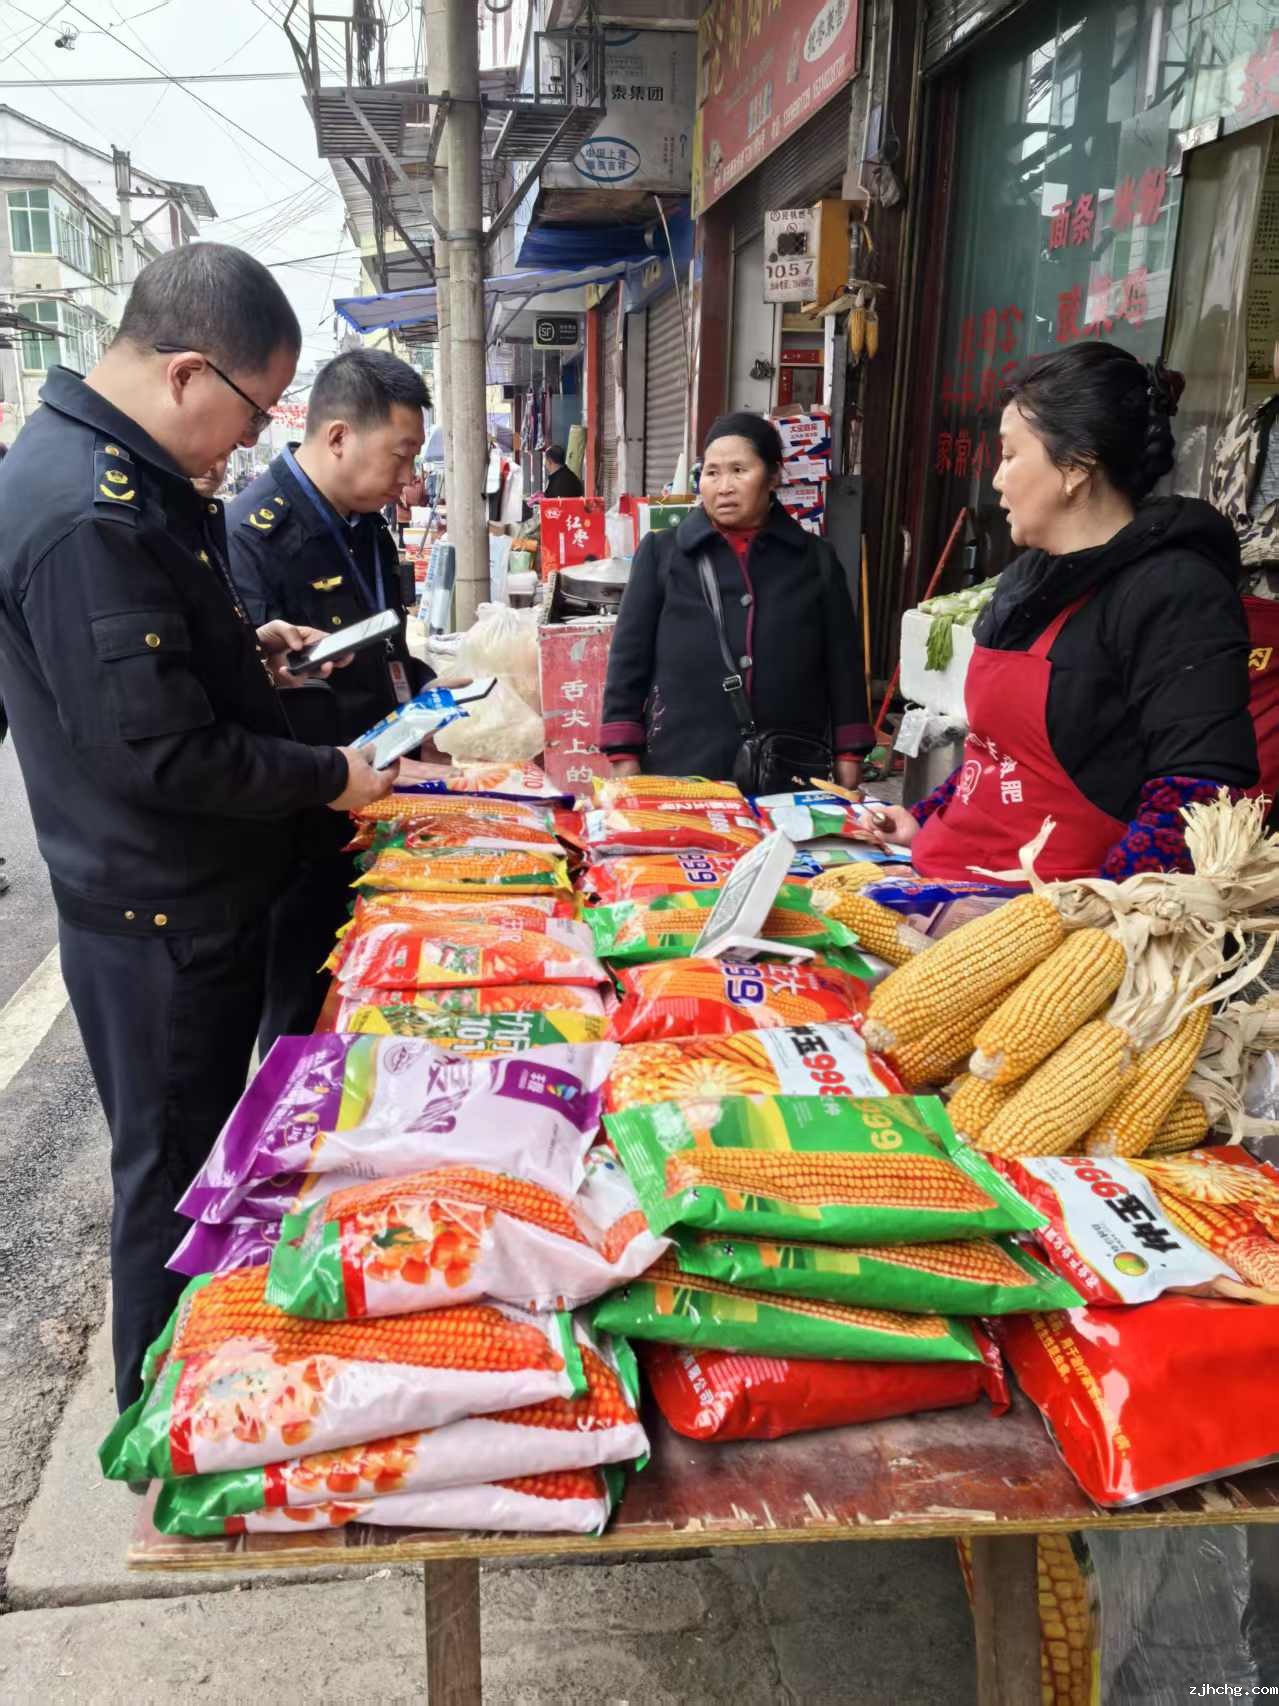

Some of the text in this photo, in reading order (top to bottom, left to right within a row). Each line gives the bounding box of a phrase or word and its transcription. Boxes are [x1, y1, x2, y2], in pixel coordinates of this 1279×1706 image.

[1047, 193, 1095, 250] 面条
[766, 261, 814, 279] 1057
[934, 429, 1002, 482] 家常小
[565, 514, 590, 548] 红枣
